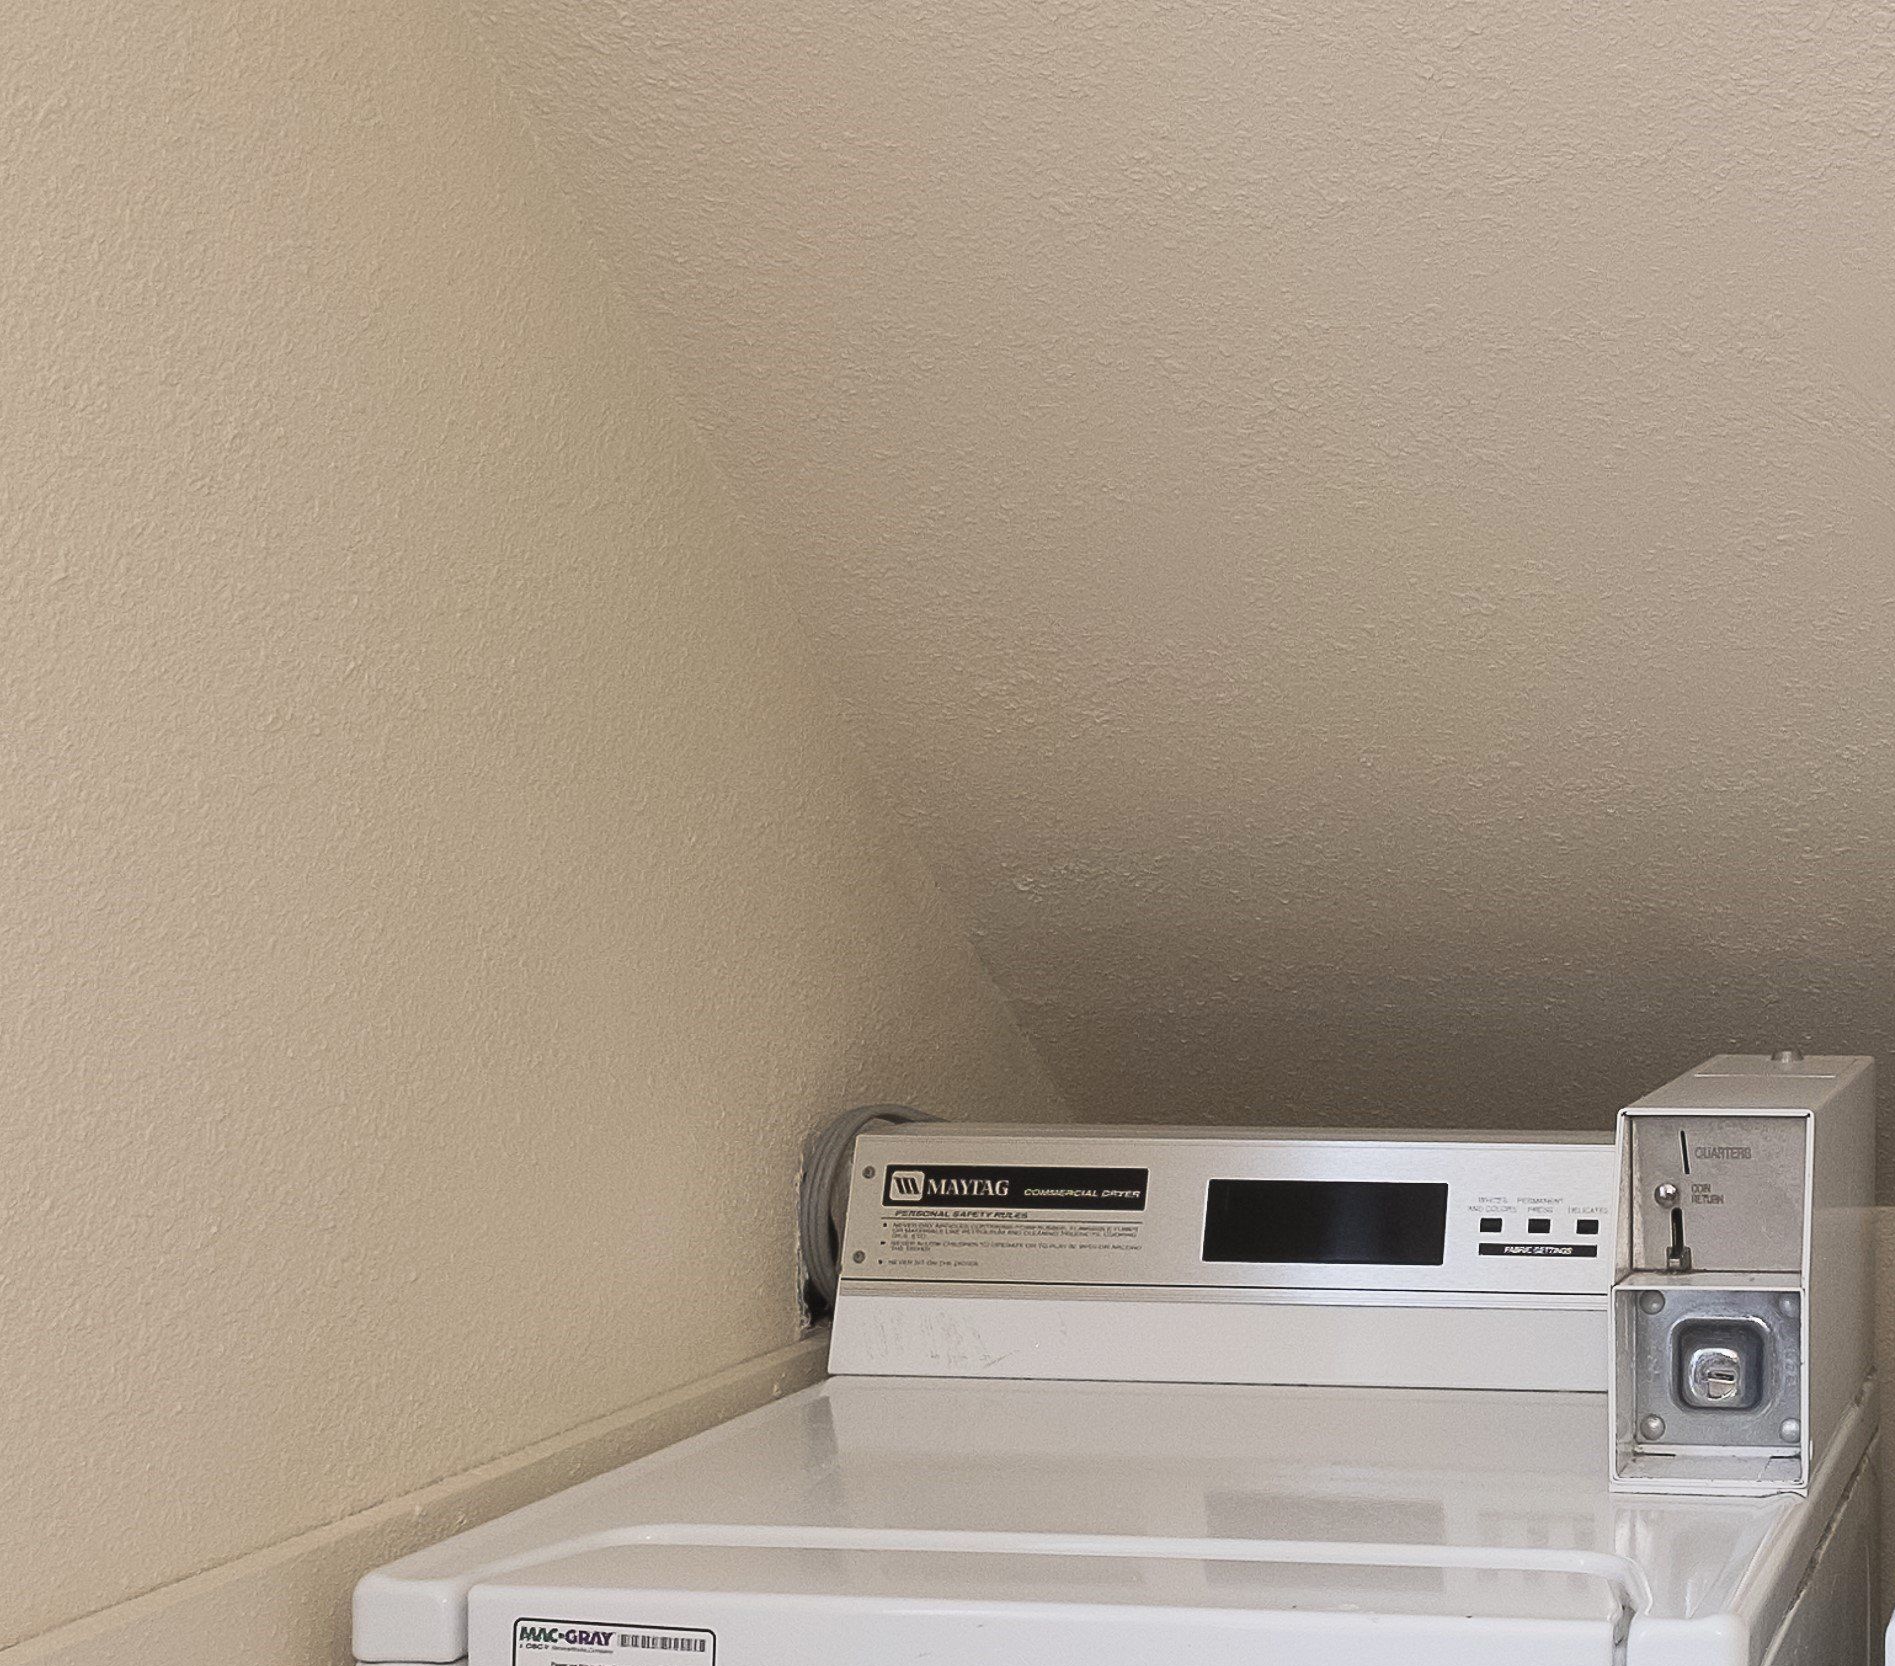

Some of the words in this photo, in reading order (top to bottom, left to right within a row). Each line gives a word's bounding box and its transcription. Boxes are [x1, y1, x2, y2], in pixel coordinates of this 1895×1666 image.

[927, 1179, 1010, 1196] MAYTAG
[1023, 1187, 1098, 1198] COMMERCIAL
[1101, 1189, 1142, 1198] DRYER
